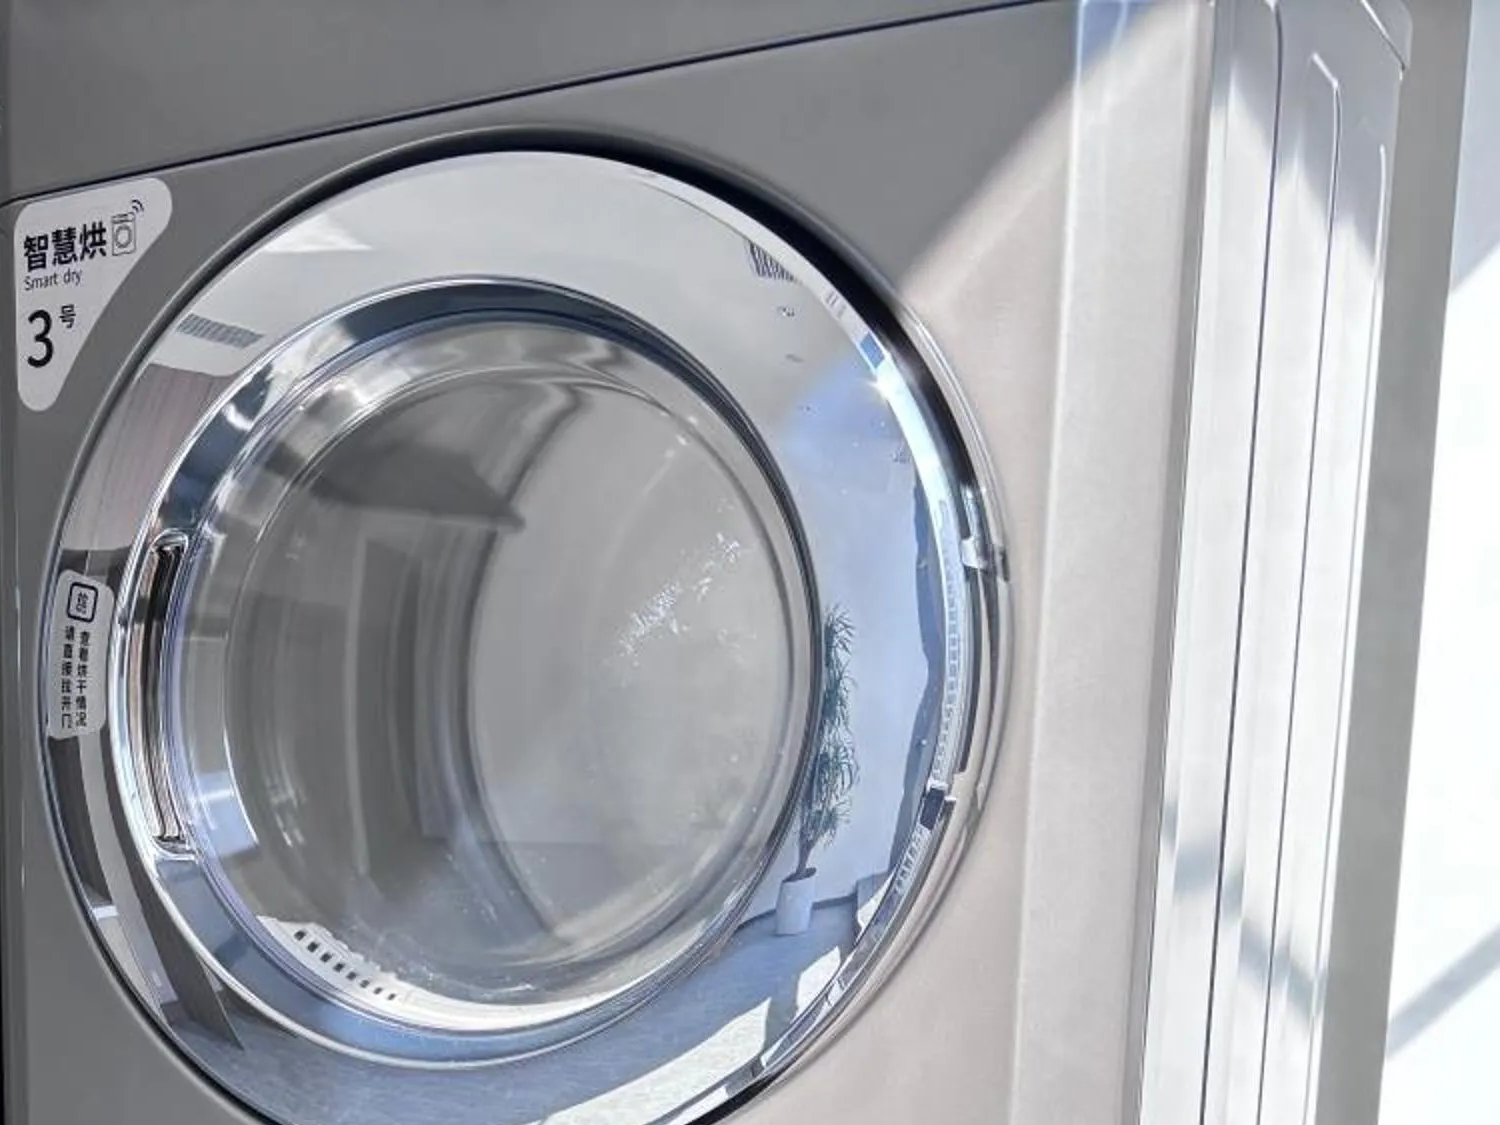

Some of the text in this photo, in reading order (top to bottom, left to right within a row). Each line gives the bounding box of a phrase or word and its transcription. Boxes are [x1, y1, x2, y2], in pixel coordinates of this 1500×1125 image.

[23, 221, 107, 272] 智慧烘
[24, 267, 84, 291] Smart dry
